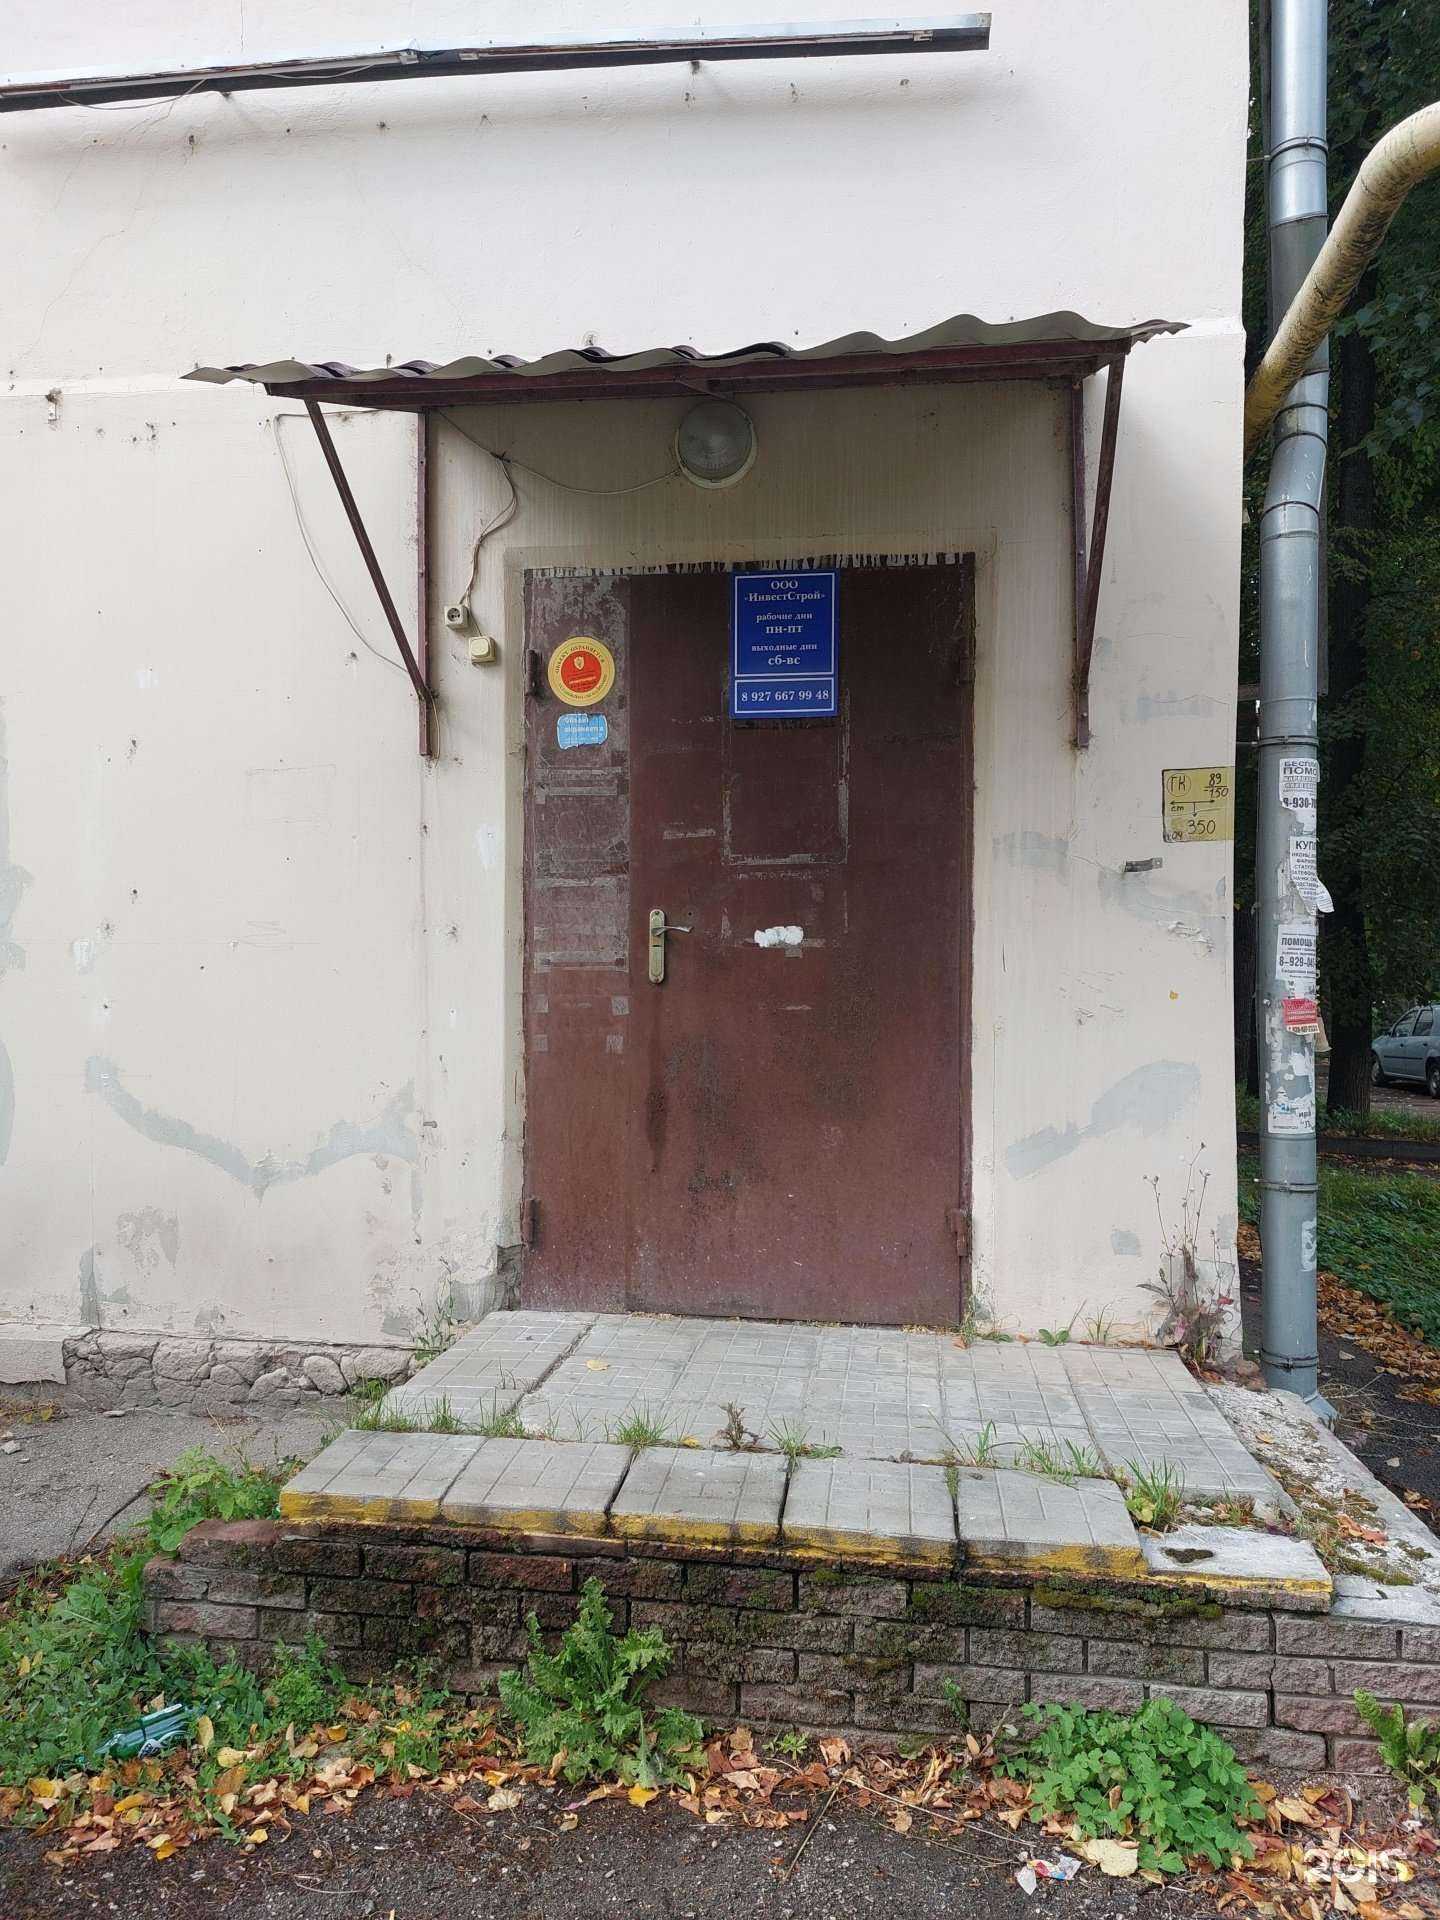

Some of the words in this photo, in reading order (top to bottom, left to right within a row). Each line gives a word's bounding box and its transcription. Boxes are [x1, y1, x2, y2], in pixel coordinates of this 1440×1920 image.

[771, 580, 798, 589] ООО
[756, 612, 793, 623] рабочие
[795, 612, 813, 620] дни
[766, 625, 803, 634] пн-пт
[751, 644, 797, 652] выходные
[767, 655, 801, 666] сб-вс
[741, 692, 748, 701] 8
[751, 691, 771, 701] 927
[774, 691, 795, 700] 667
[798, 690, 812, 700] 99
[815, 690, 829, 700] 48
[1187, 819, 1216, 834] 350
[1281, 937, 1313, 947] ПОМОЩЬ
